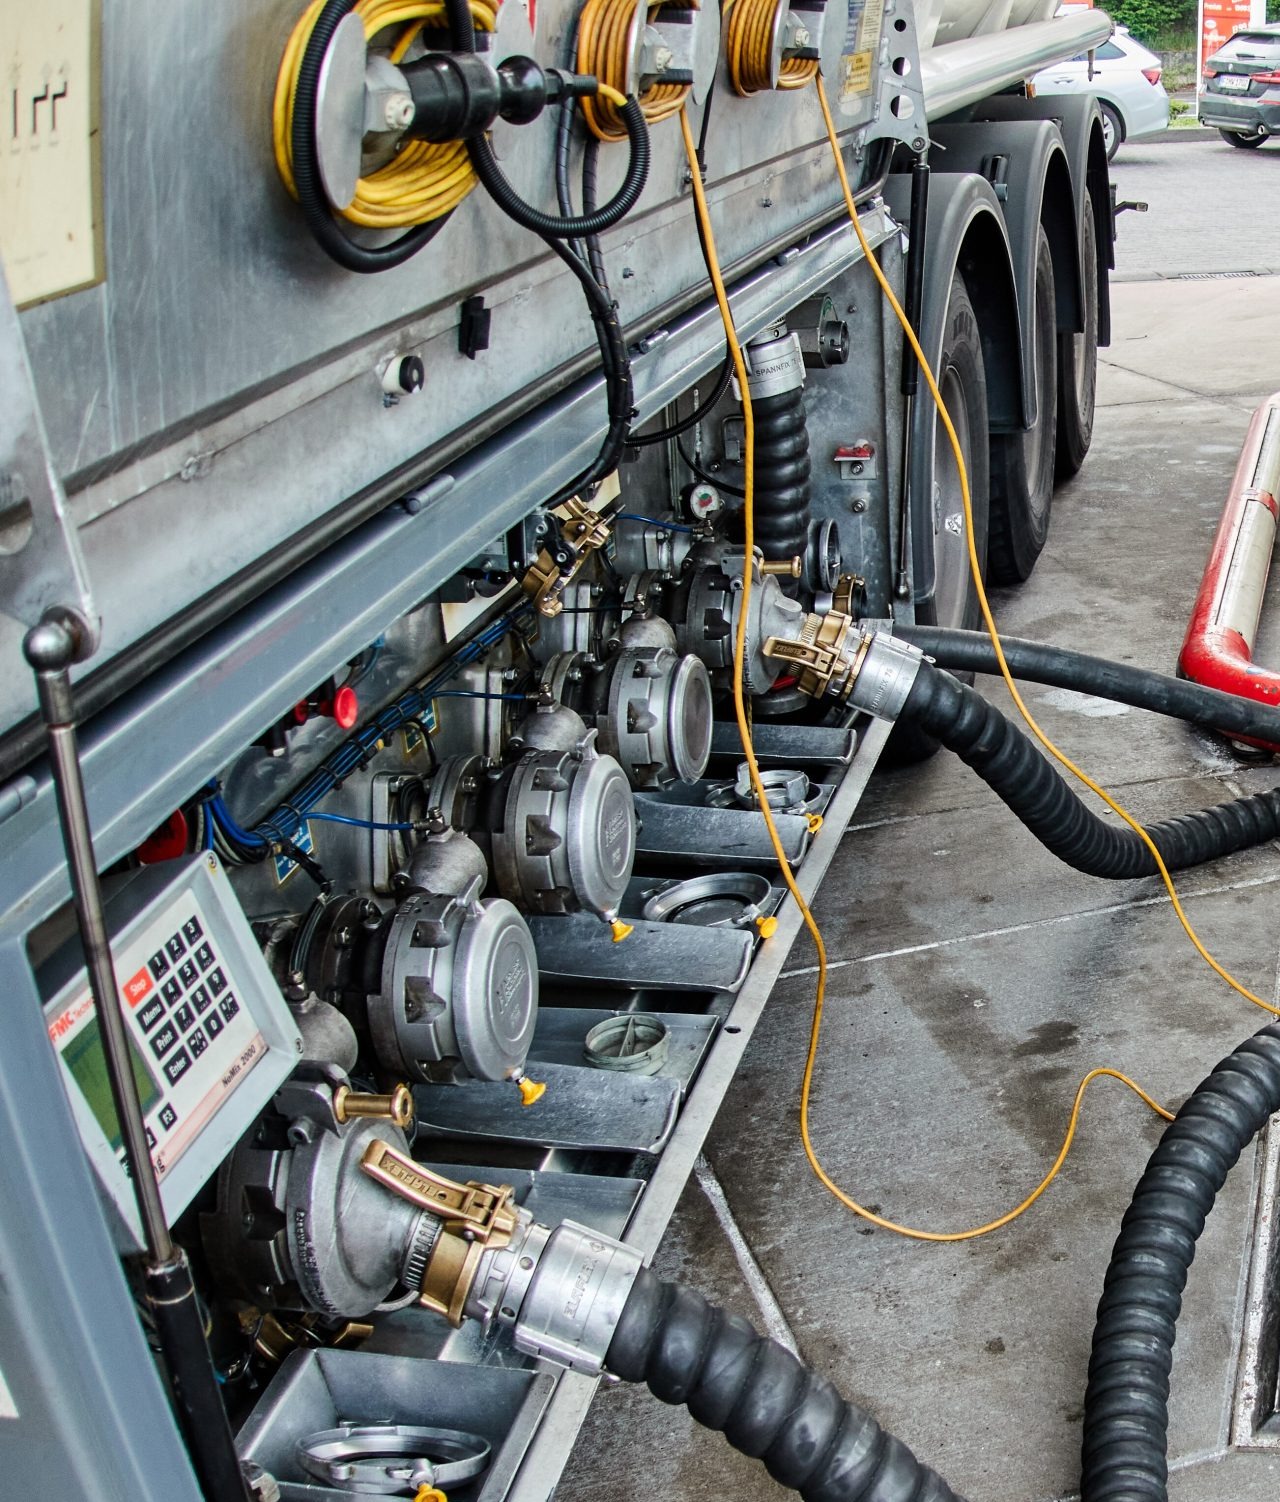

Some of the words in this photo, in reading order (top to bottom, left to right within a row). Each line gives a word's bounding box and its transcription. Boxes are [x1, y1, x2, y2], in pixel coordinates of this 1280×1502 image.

[755, 361, 791, 377] SPANNFIX
[187, 922, 195, 934] 3
[170, 939, 179, 951] 2
[183, 963, 191, 977] 5
[212, 973, 220, 983] 9
[130, 979, 147, 997] Stop
[167, 982, 175, 994] 4
[141, 1003, 162, 1027] Menu
[178, 1007, 186, 1020] 7
[48, 1010, 75, 1042] FMC
[155, 1030, 174, 1052] Print
[168, 1056, 188, 1078] Enter
[221, 1063, 242, 1088] NoMix
[240, 1044, 257, 1066] 2000
[381, 1159, 438, 1198] ELAFLEX
